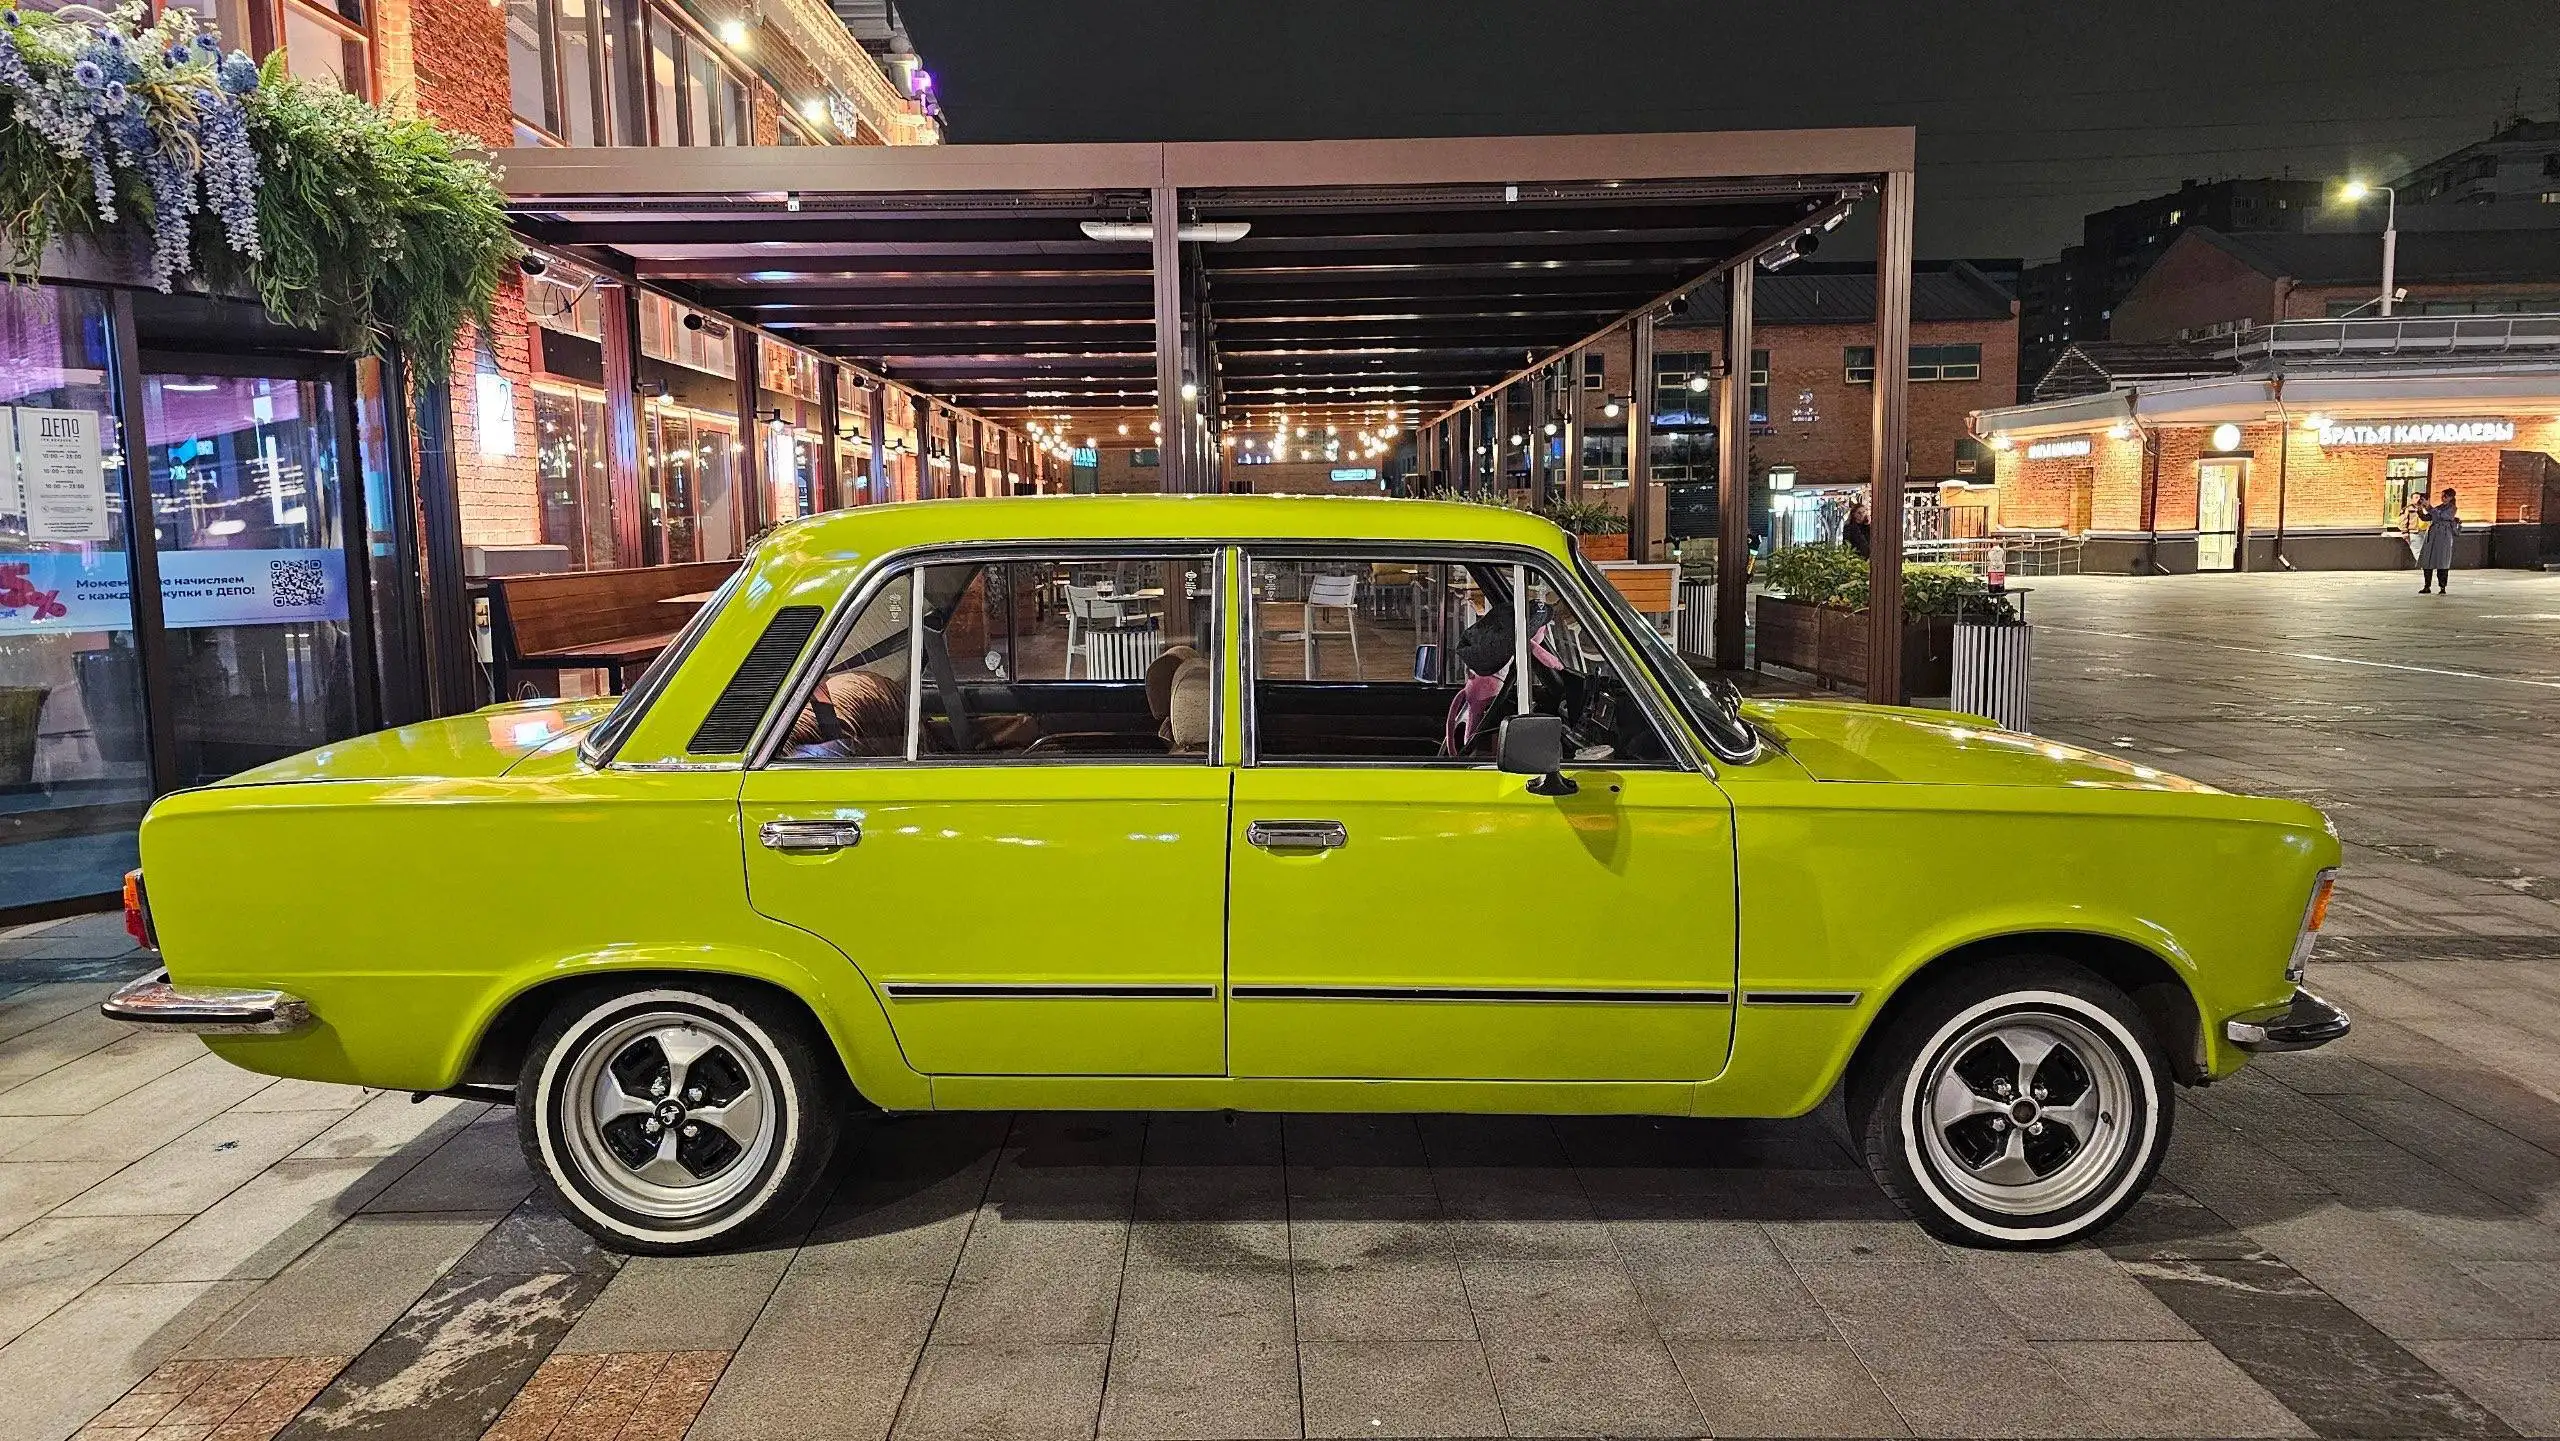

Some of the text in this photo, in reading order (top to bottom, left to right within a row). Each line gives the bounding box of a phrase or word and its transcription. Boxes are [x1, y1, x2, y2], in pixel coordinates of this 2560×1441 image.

[41, 417, 79, 438] ДЕПО
[2319, 419, 2514, 444] БРАТЬЯ КАРАВАЕВЫ
[174, 576, 244, 585] начисляем
[89, 591, 130, 601] кажд
[163, 590, 202, 599] купки
[216, 586, 255, 597] ДЕПО!
